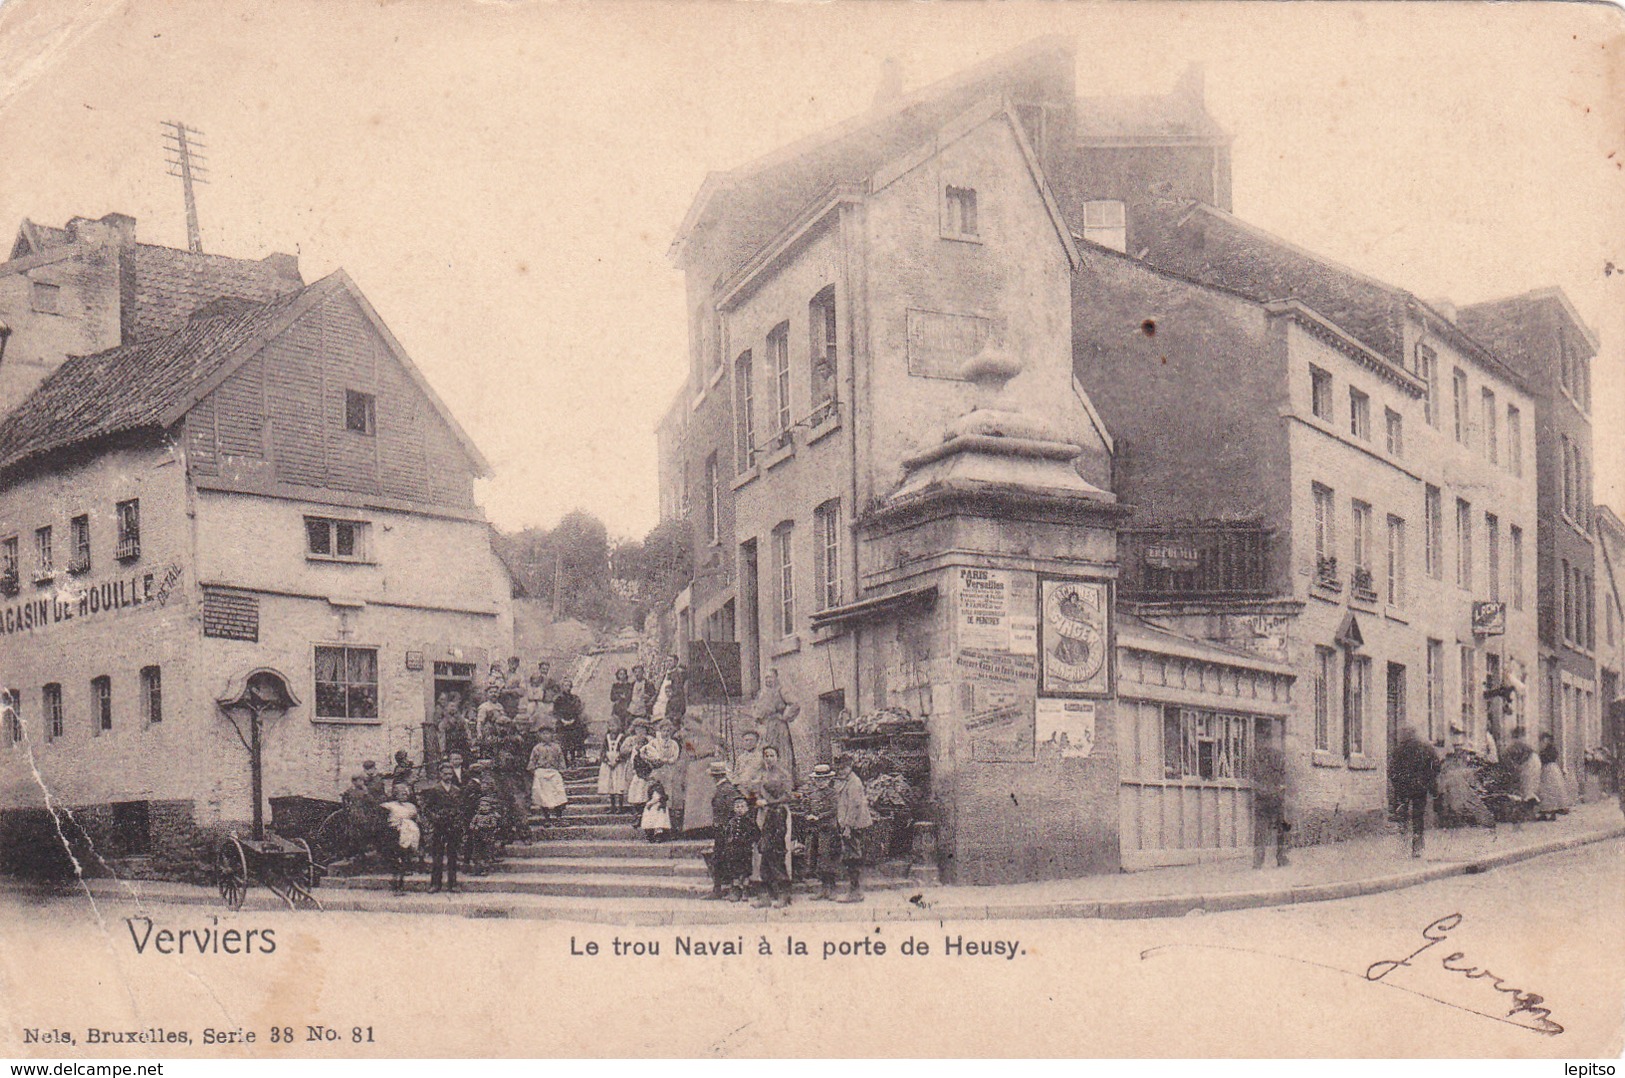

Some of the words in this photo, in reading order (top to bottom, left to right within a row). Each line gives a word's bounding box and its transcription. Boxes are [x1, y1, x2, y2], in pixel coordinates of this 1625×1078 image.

[966, 579, 1004, 590] Versailles
[0, 598, 48, 635] AGASIN
[53, 597, 73, 622] DE
[79, 573, 155, 616] HOUILLE
[1049, 615, 1100, 647] SINGER
[126, 915, 277, 954] Verviers
[570, 937, 599, 957] Le
[612, 937, 659, 956] trou
[675, 936, 744, 956] Navai
[758, 936, 772, 956] à
[787, 937, 808, 956] la
[823, 938, 886, 960] porte
[901, 937, 930, 956] de
[945, 936, 1027, 960] Heusy.
[24, 1028, 77, 1046] Nels,
[86, 1028, 194, 1046] Bruxelles,
[203, 1028, 256, 1044] Serie
[270, 1026, 294, 1044] 38
[307, 1025, 342, 1042] No.
[352, 1027, 375, 1043] 81
